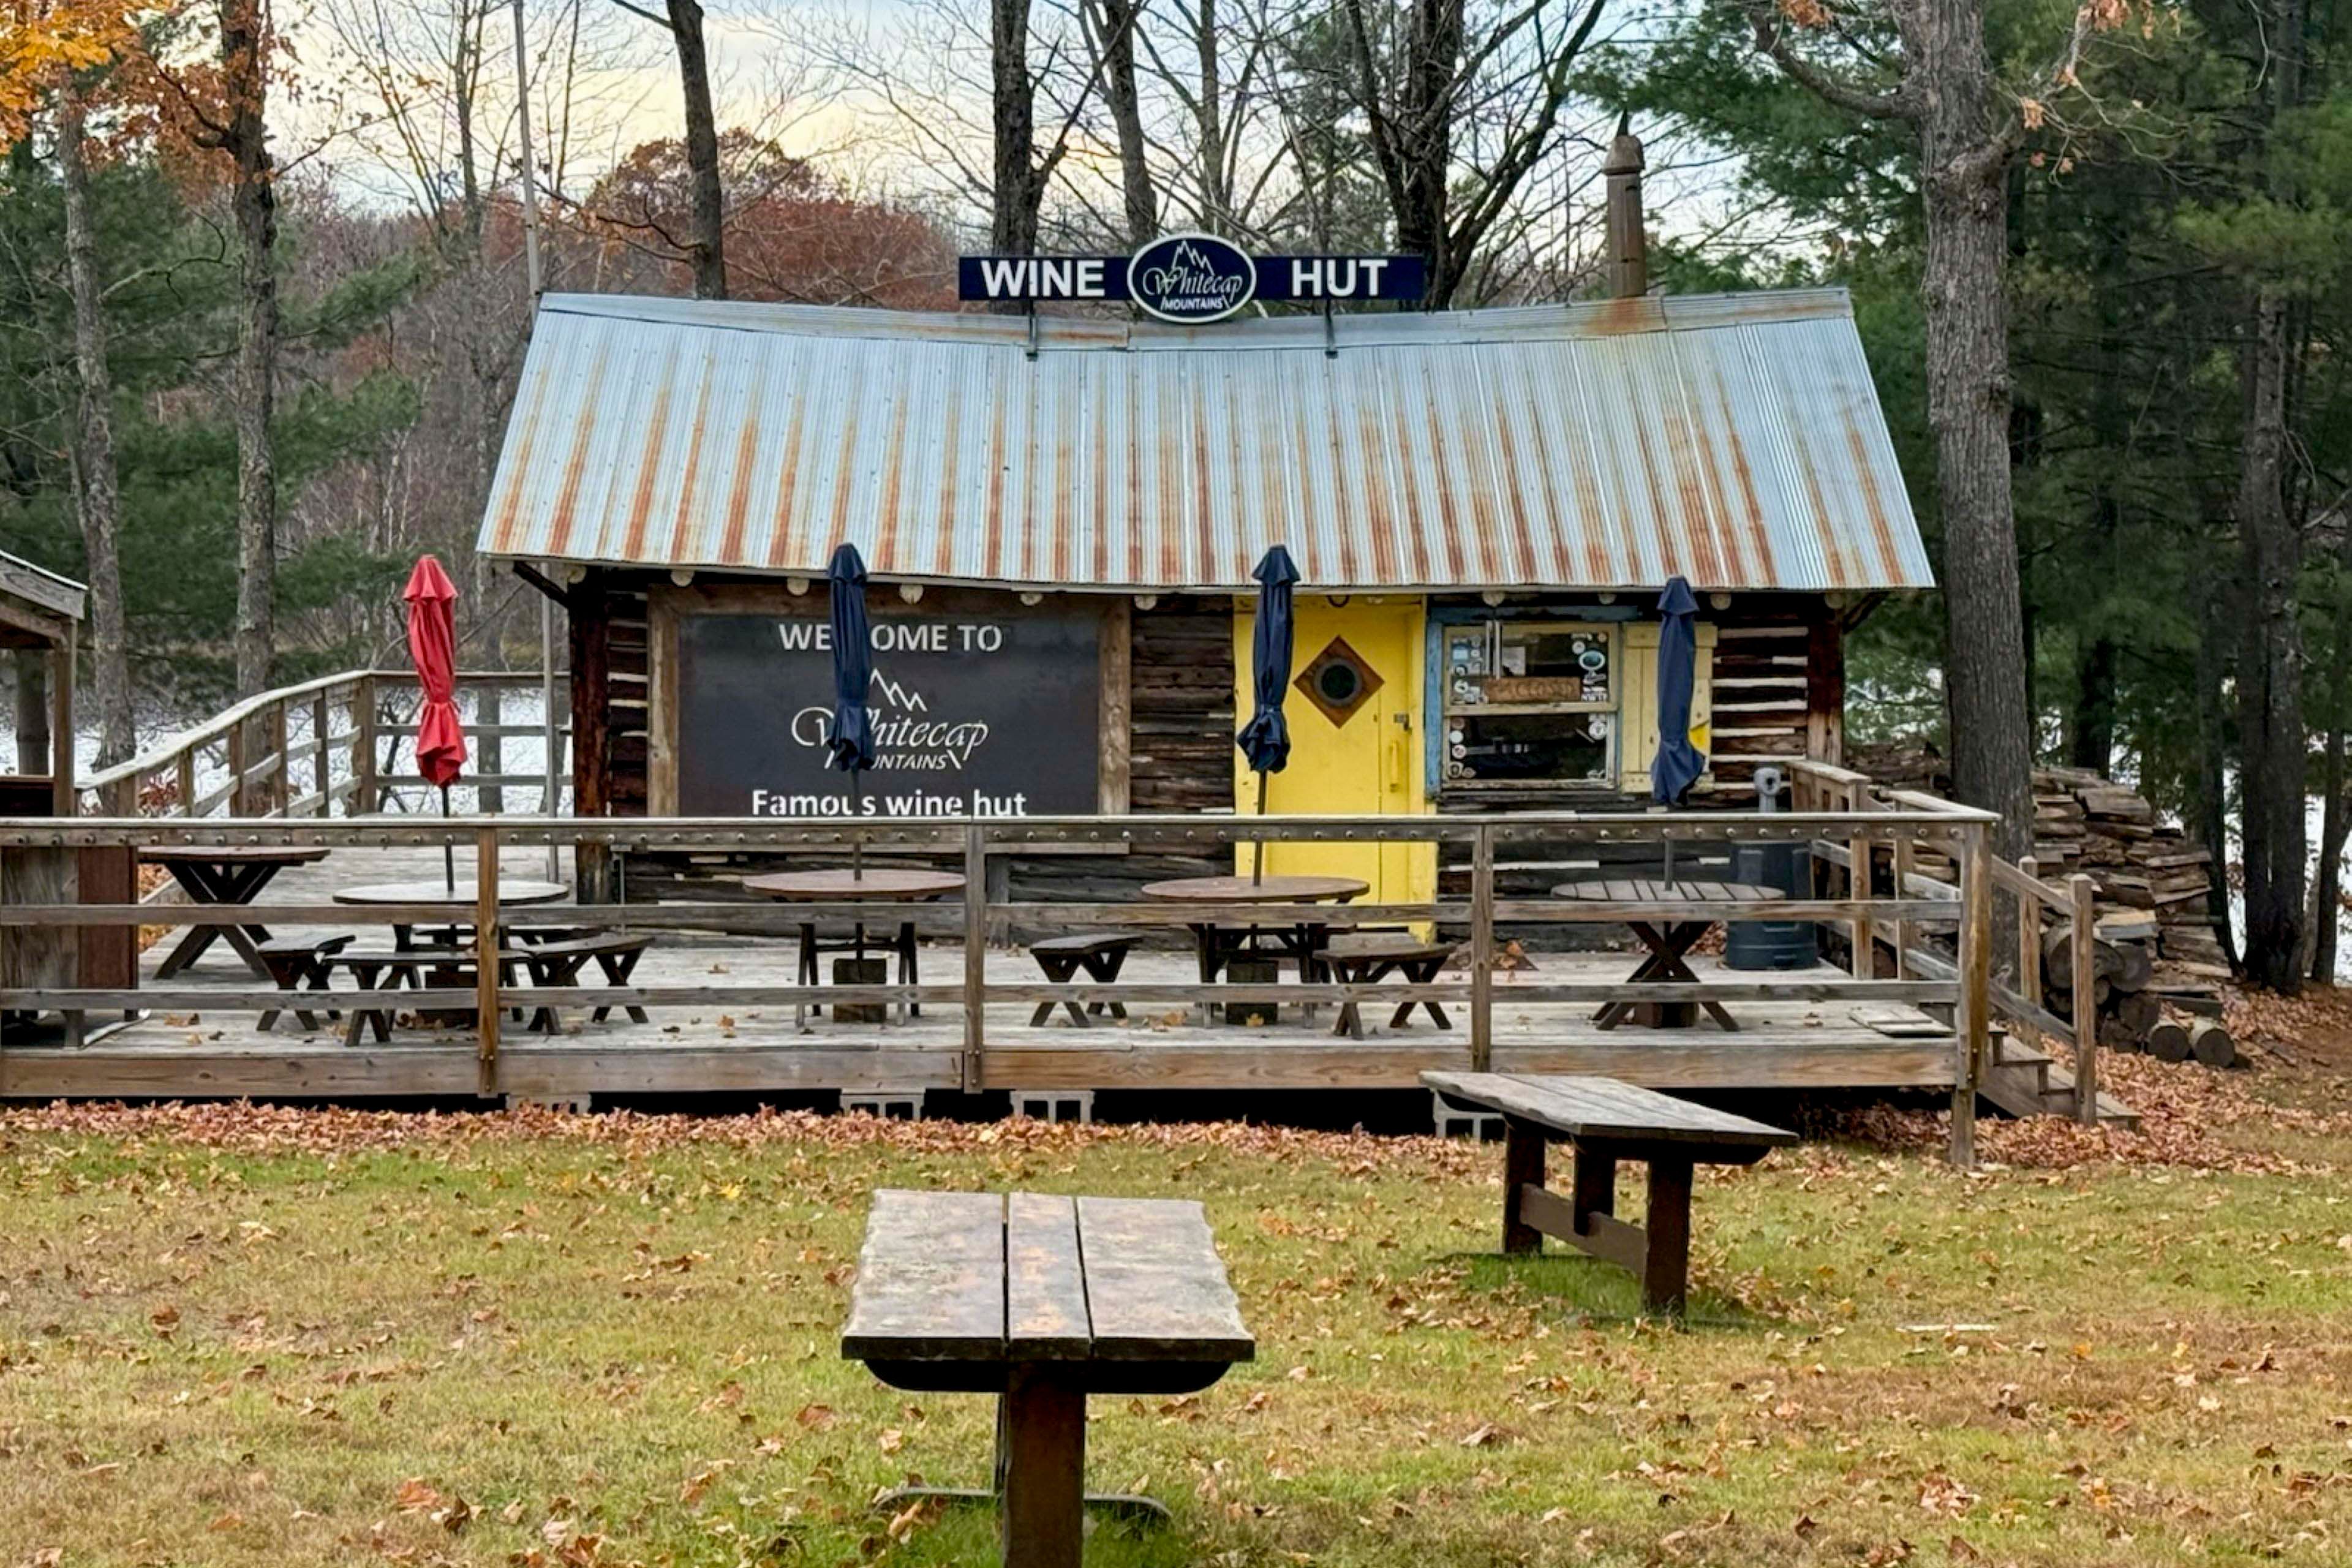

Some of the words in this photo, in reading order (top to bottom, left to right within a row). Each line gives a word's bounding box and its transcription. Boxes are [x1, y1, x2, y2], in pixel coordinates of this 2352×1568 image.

[981, 260, 1105, 297] WINE
[1292, 259, 1388, 296] HUT
[1143, 266, 1243, 303] Whitecap
[1163, 297, 1223, 311] MOUNTAINS
[778, 624, 949, 652] WEOME
[957, 624, 1003, 652] TO
[837, 754, 949, 770] NTAINS
[886, 788, 963, 816] wine
[973, 789, 1027, 816] hut
